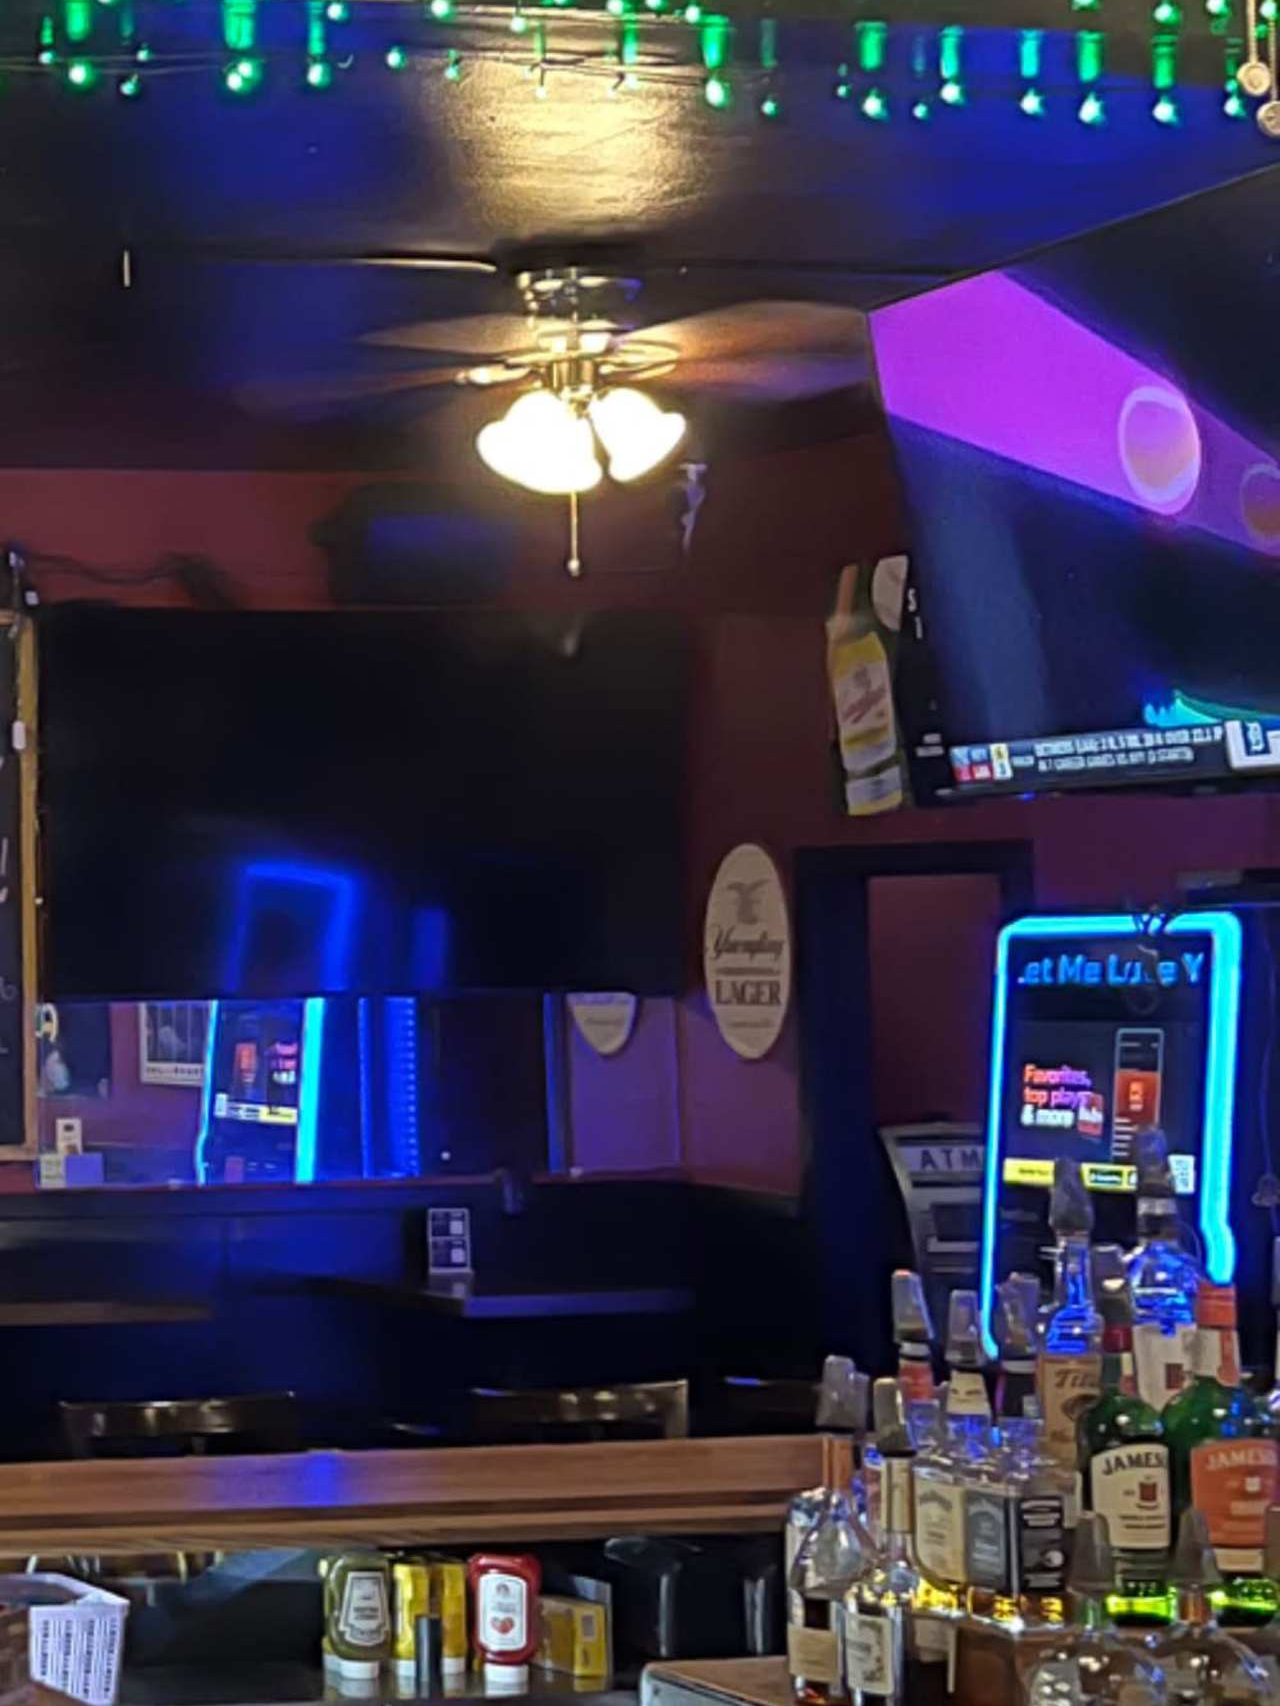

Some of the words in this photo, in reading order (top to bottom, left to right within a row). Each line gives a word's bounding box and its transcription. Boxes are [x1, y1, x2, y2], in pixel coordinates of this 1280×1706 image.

[1017, 957, 1054, 985] et
[1057, 953, 1103, 986] Me
[715, 979, 782, 1006] LAGER
[920, 1149, 980, 1170] ATM
